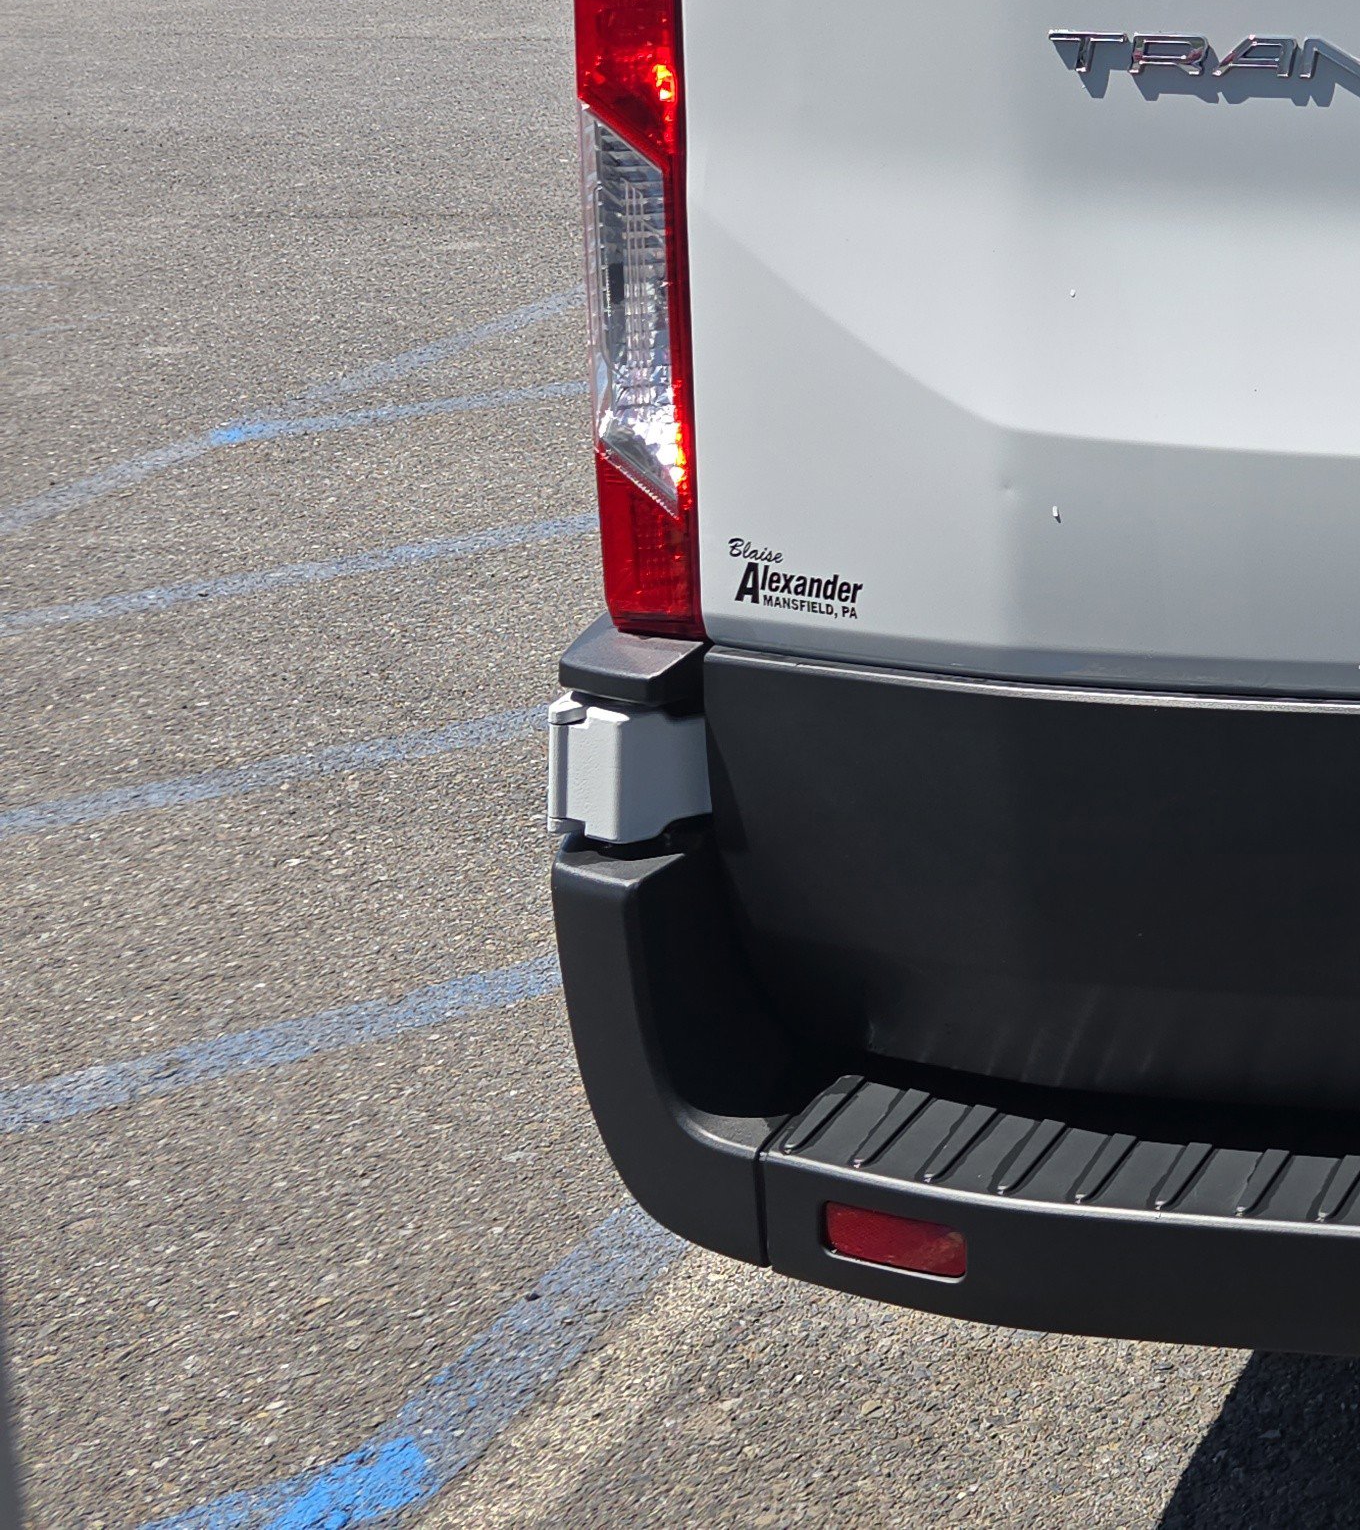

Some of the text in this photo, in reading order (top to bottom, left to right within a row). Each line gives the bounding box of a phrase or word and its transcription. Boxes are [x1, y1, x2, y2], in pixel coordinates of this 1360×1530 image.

[728, 537, 784, 564] Blaise
[734, 561, 864, 605] Alexander
[762, 593, 858, 619] MANSFIELD, PA
